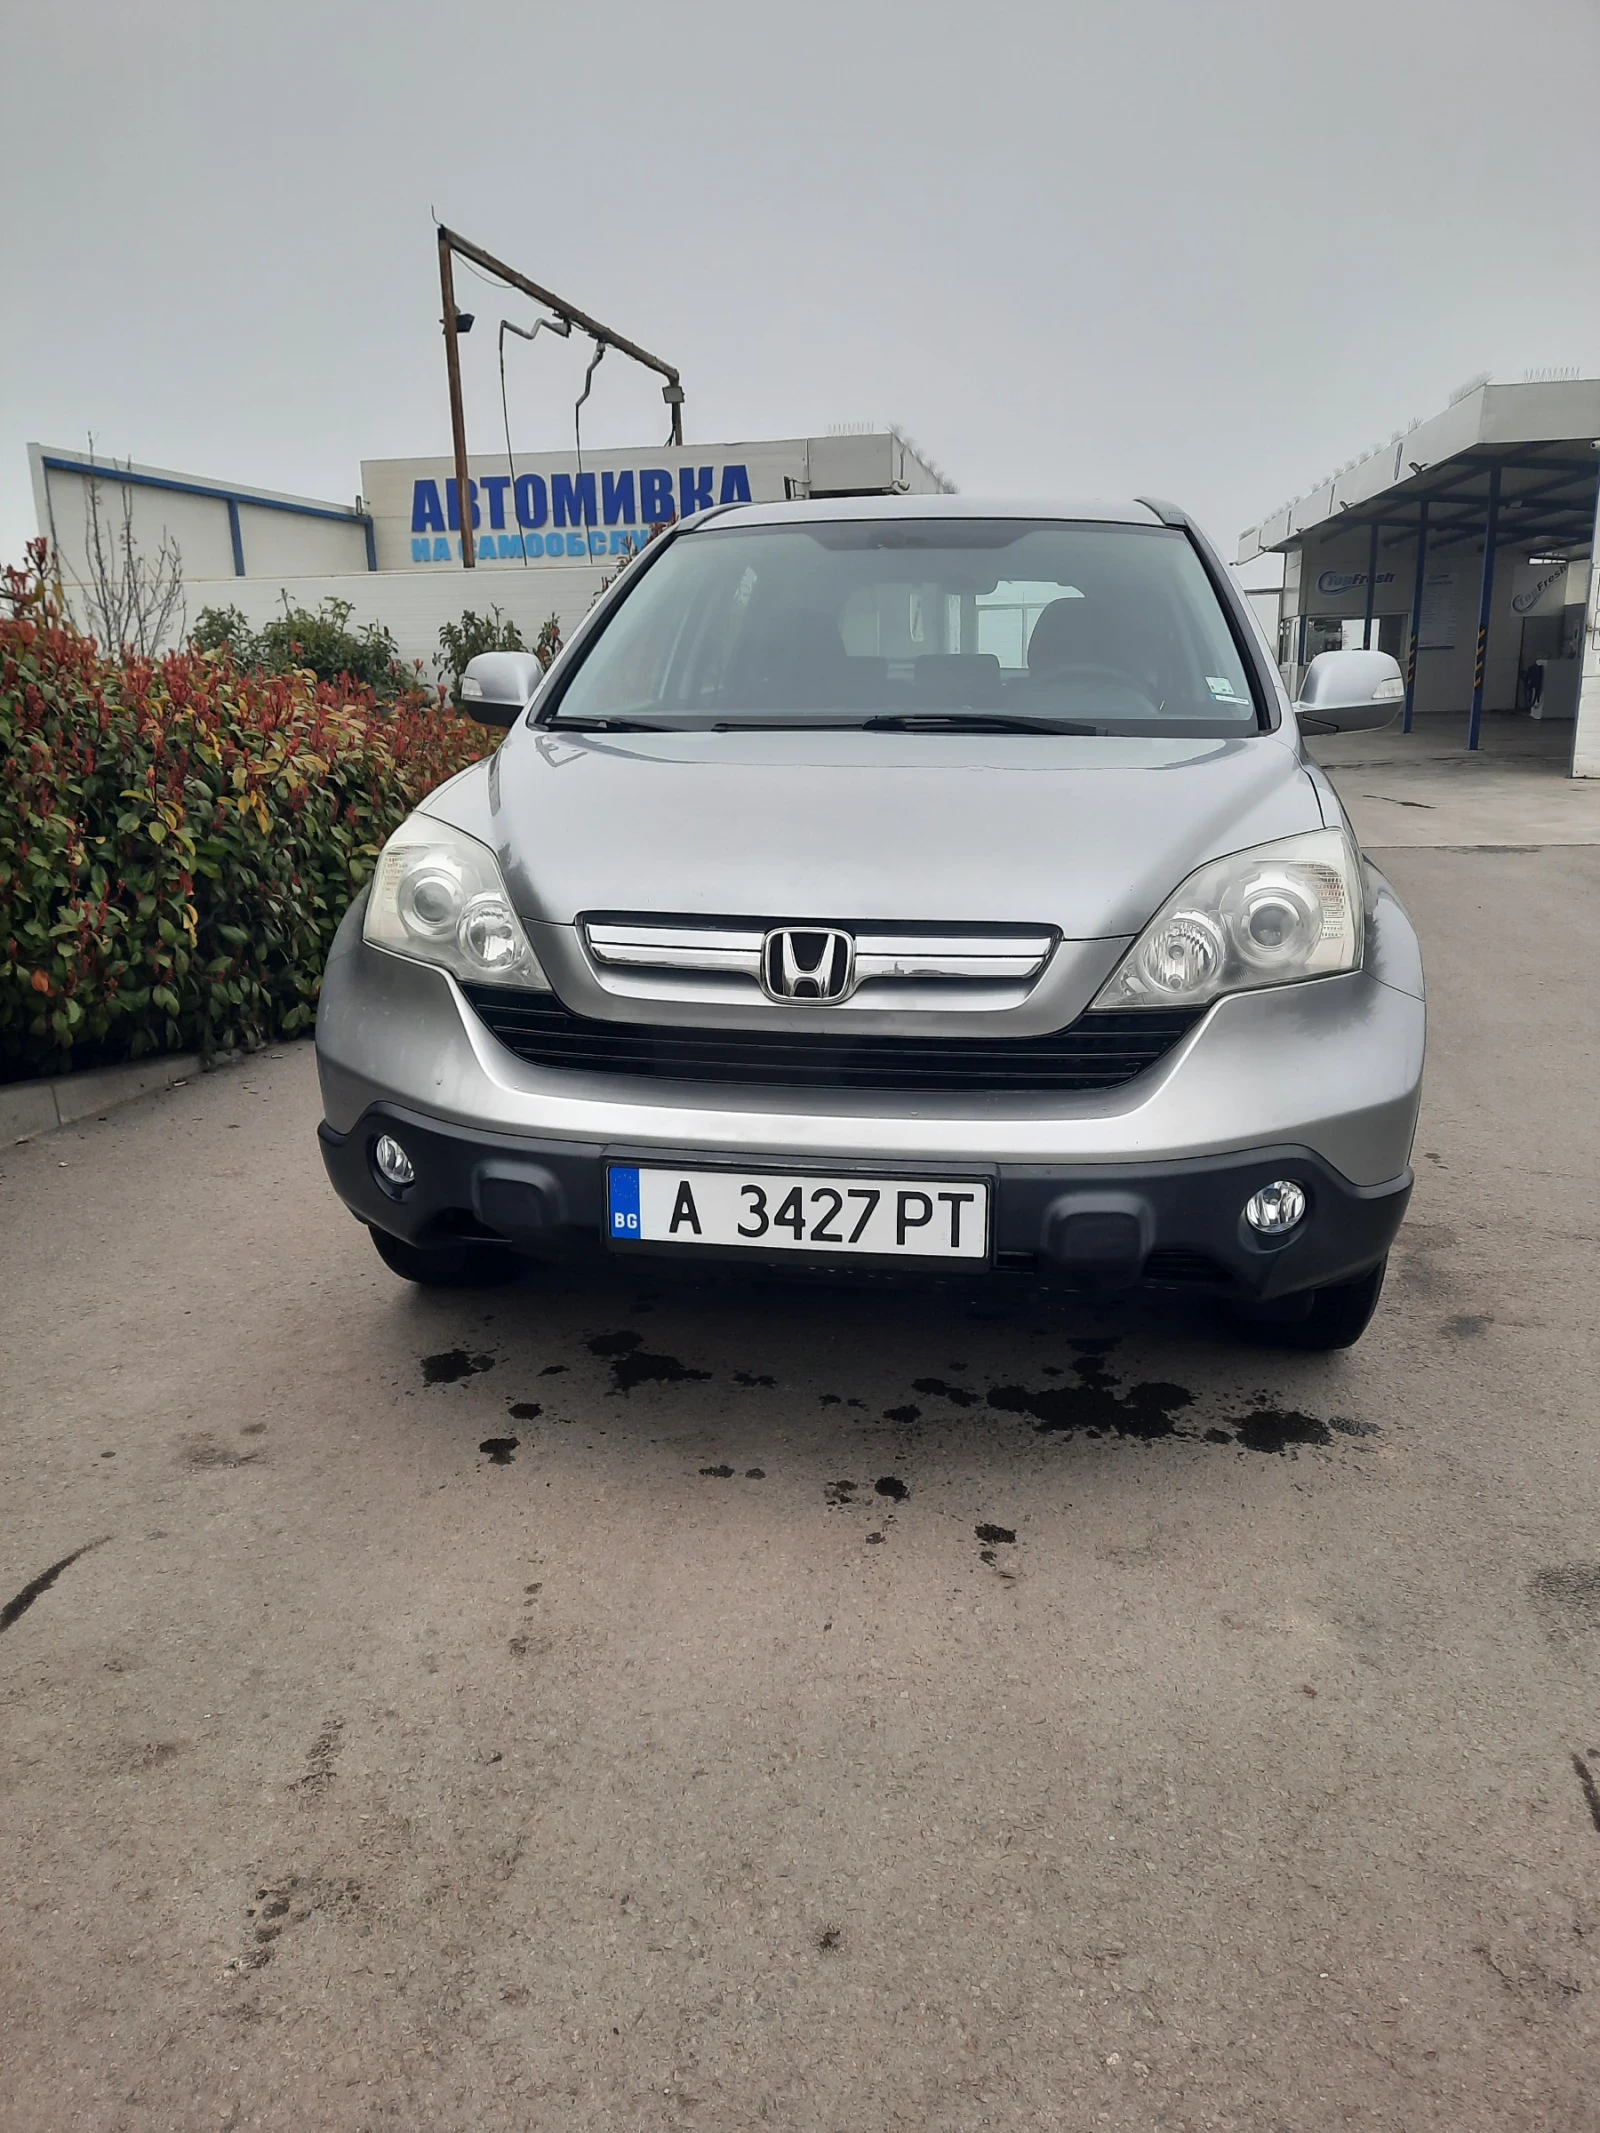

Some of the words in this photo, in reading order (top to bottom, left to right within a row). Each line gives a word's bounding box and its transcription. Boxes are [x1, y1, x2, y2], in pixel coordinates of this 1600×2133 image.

[410, 464, 753, 533] АВТОМИВКА
[411, 536, 452, 563] НА
[1327, 572, 1395, 587] TopFrsh
[615, 1212, 638, 1230] BG
[669, 1180, 702, 1235] A
[737, 1184, 881, 1244] 3427
[896, 1190, 975, 1248] PT
